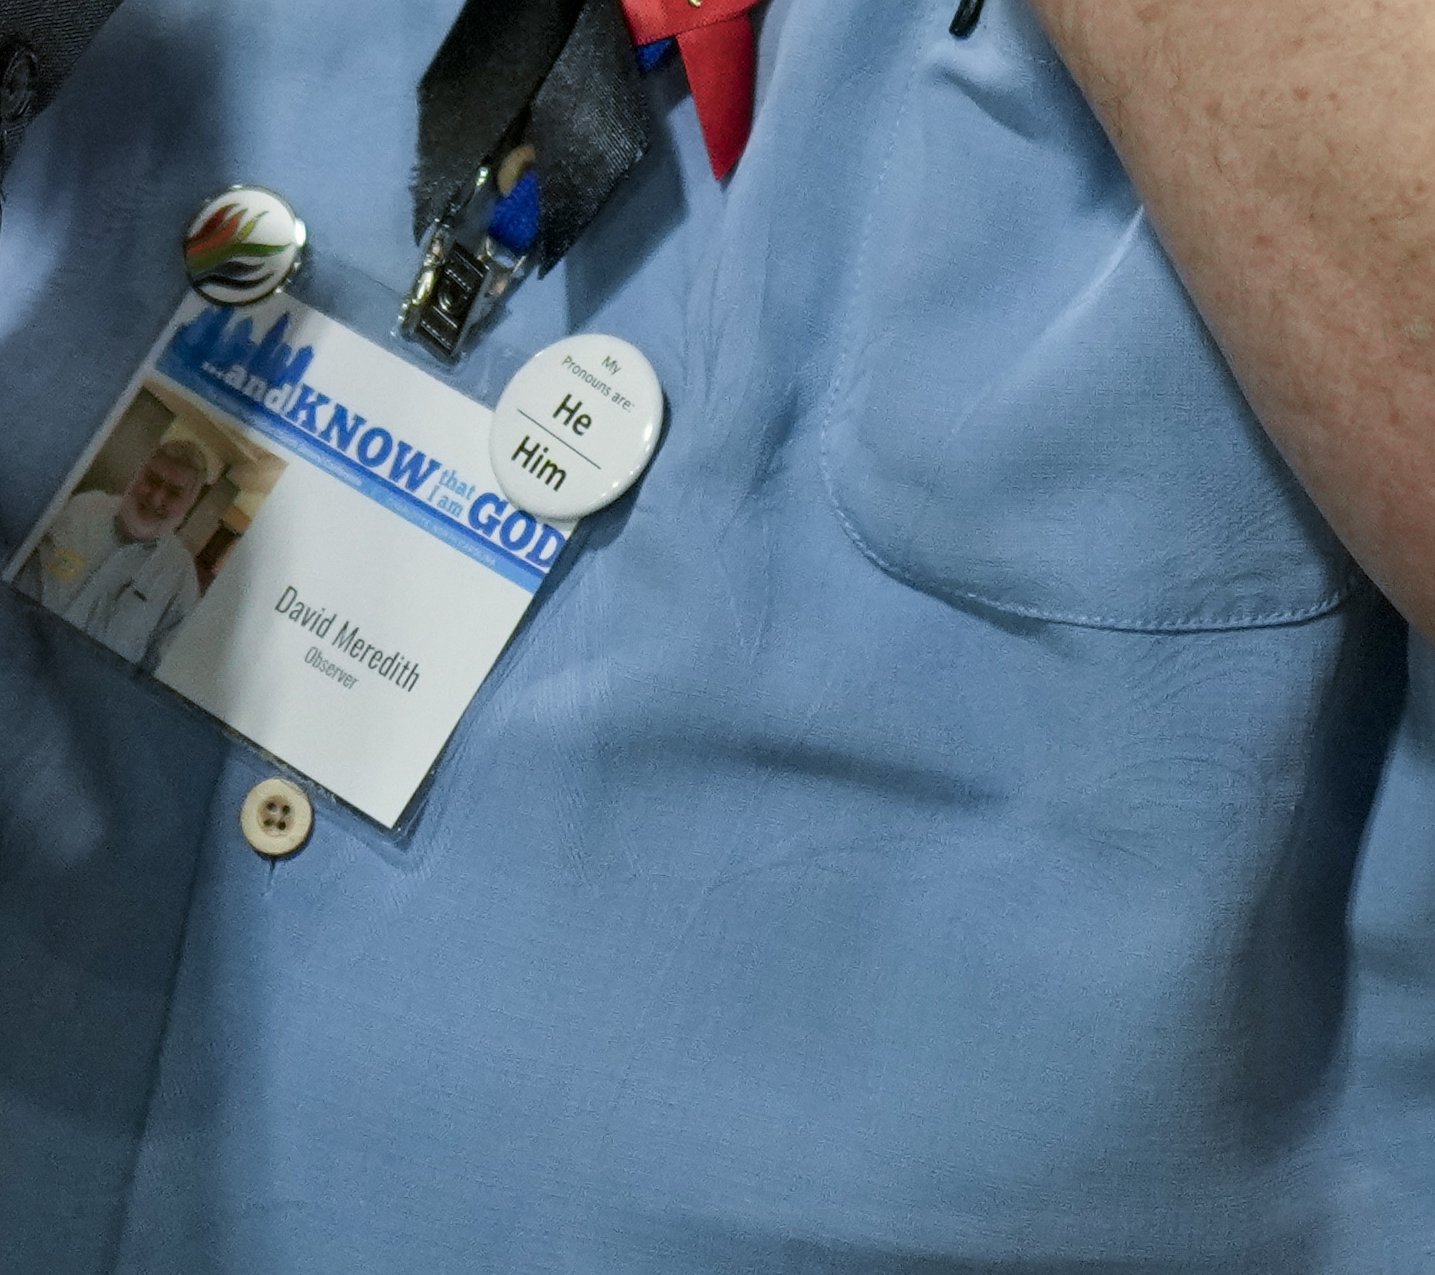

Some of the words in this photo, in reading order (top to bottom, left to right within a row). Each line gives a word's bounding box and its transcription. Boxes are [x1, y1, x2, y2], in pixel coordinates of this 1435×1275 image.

[561, 354, 612, 397] Pronouns
[610, 390, 635, 413] are:
[601, 355, 622, 376] My
[552, 393, 593, 437] He
[285, 382, 443, 493] KNOW
[438, 468, 477, 501] that
[467, 492, 567, 568] GOD
[510, 434, 568, 492] Him
[437, 495, 465, 519] am
[274, 585, 338, 639] David
[331, 620, 421, 693] Meredith
[304, 645, 360, 690] Observer
